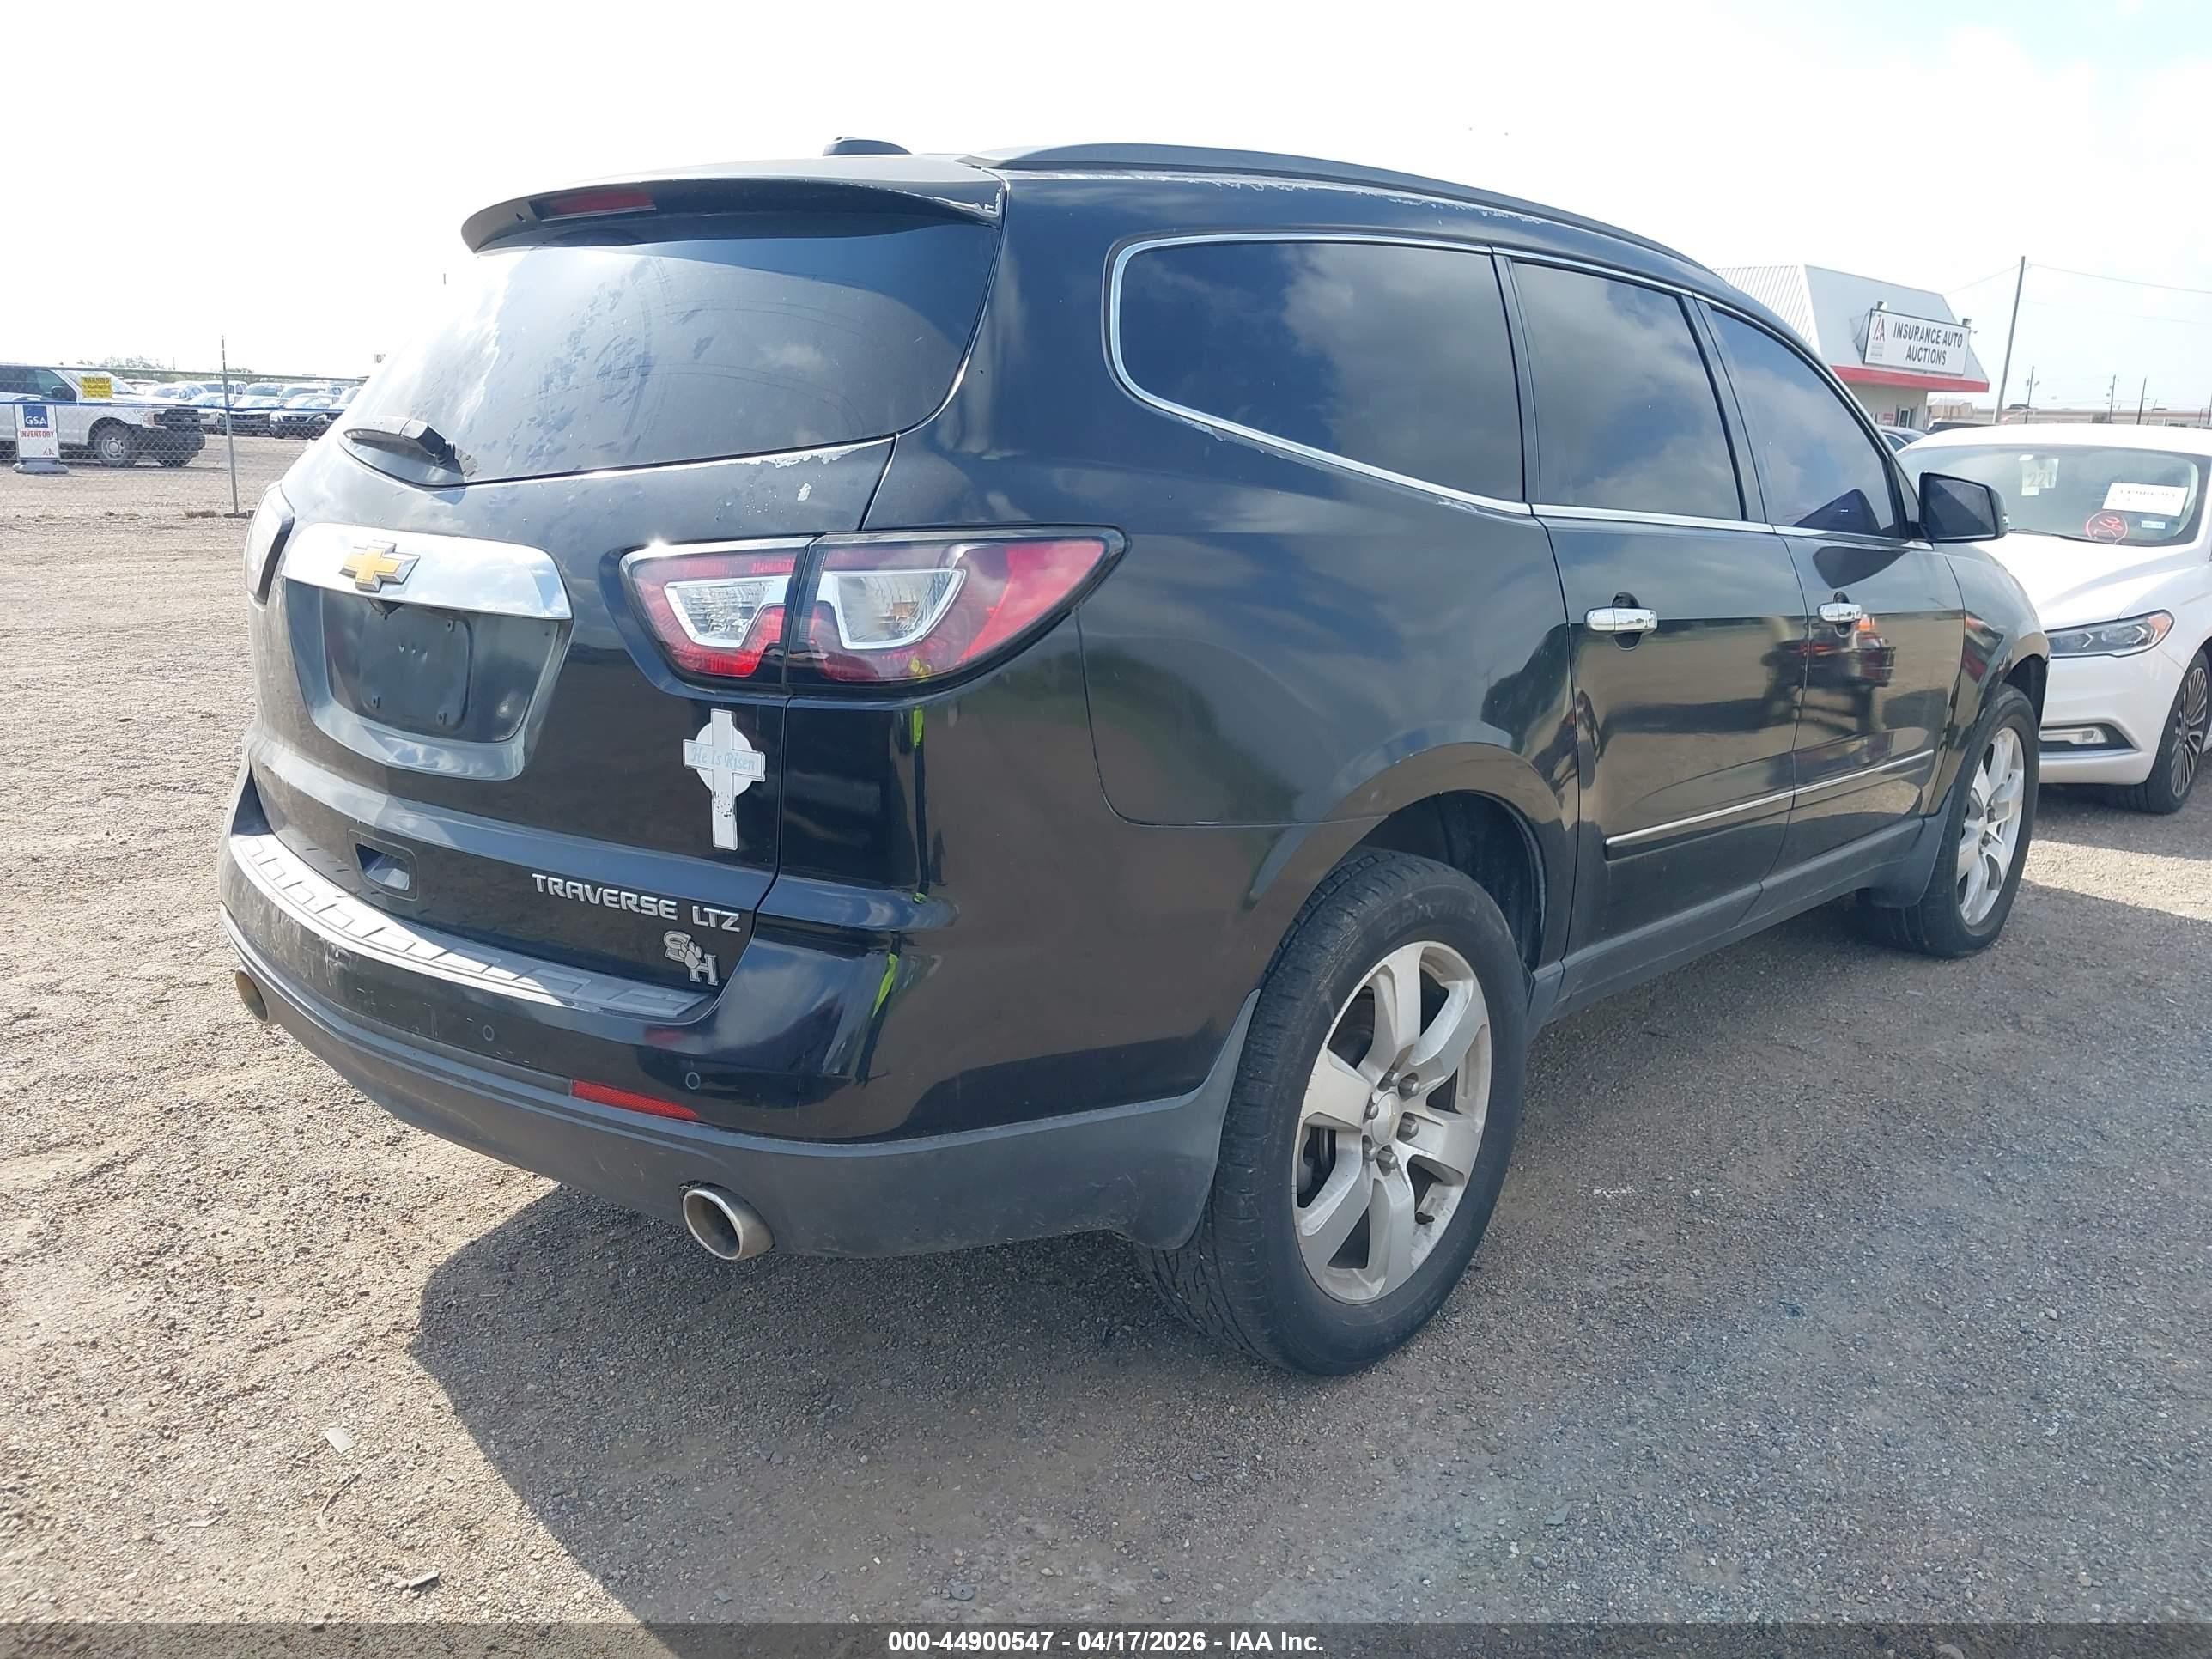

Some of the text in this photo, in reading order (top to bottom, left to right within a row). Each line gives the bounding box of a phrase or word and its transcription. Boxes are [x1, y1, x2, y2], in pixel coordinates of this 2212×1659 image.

[1893, 322, 1963, 348] INSURANCE AUTO
[1905, 345, 1947, 365] AUCTIONS
[25, 416, 46, 424] GSA
[691, 745, 756, 771] He Is Risen
[532, 873, 741, 933] TRAVERSE LTZ
